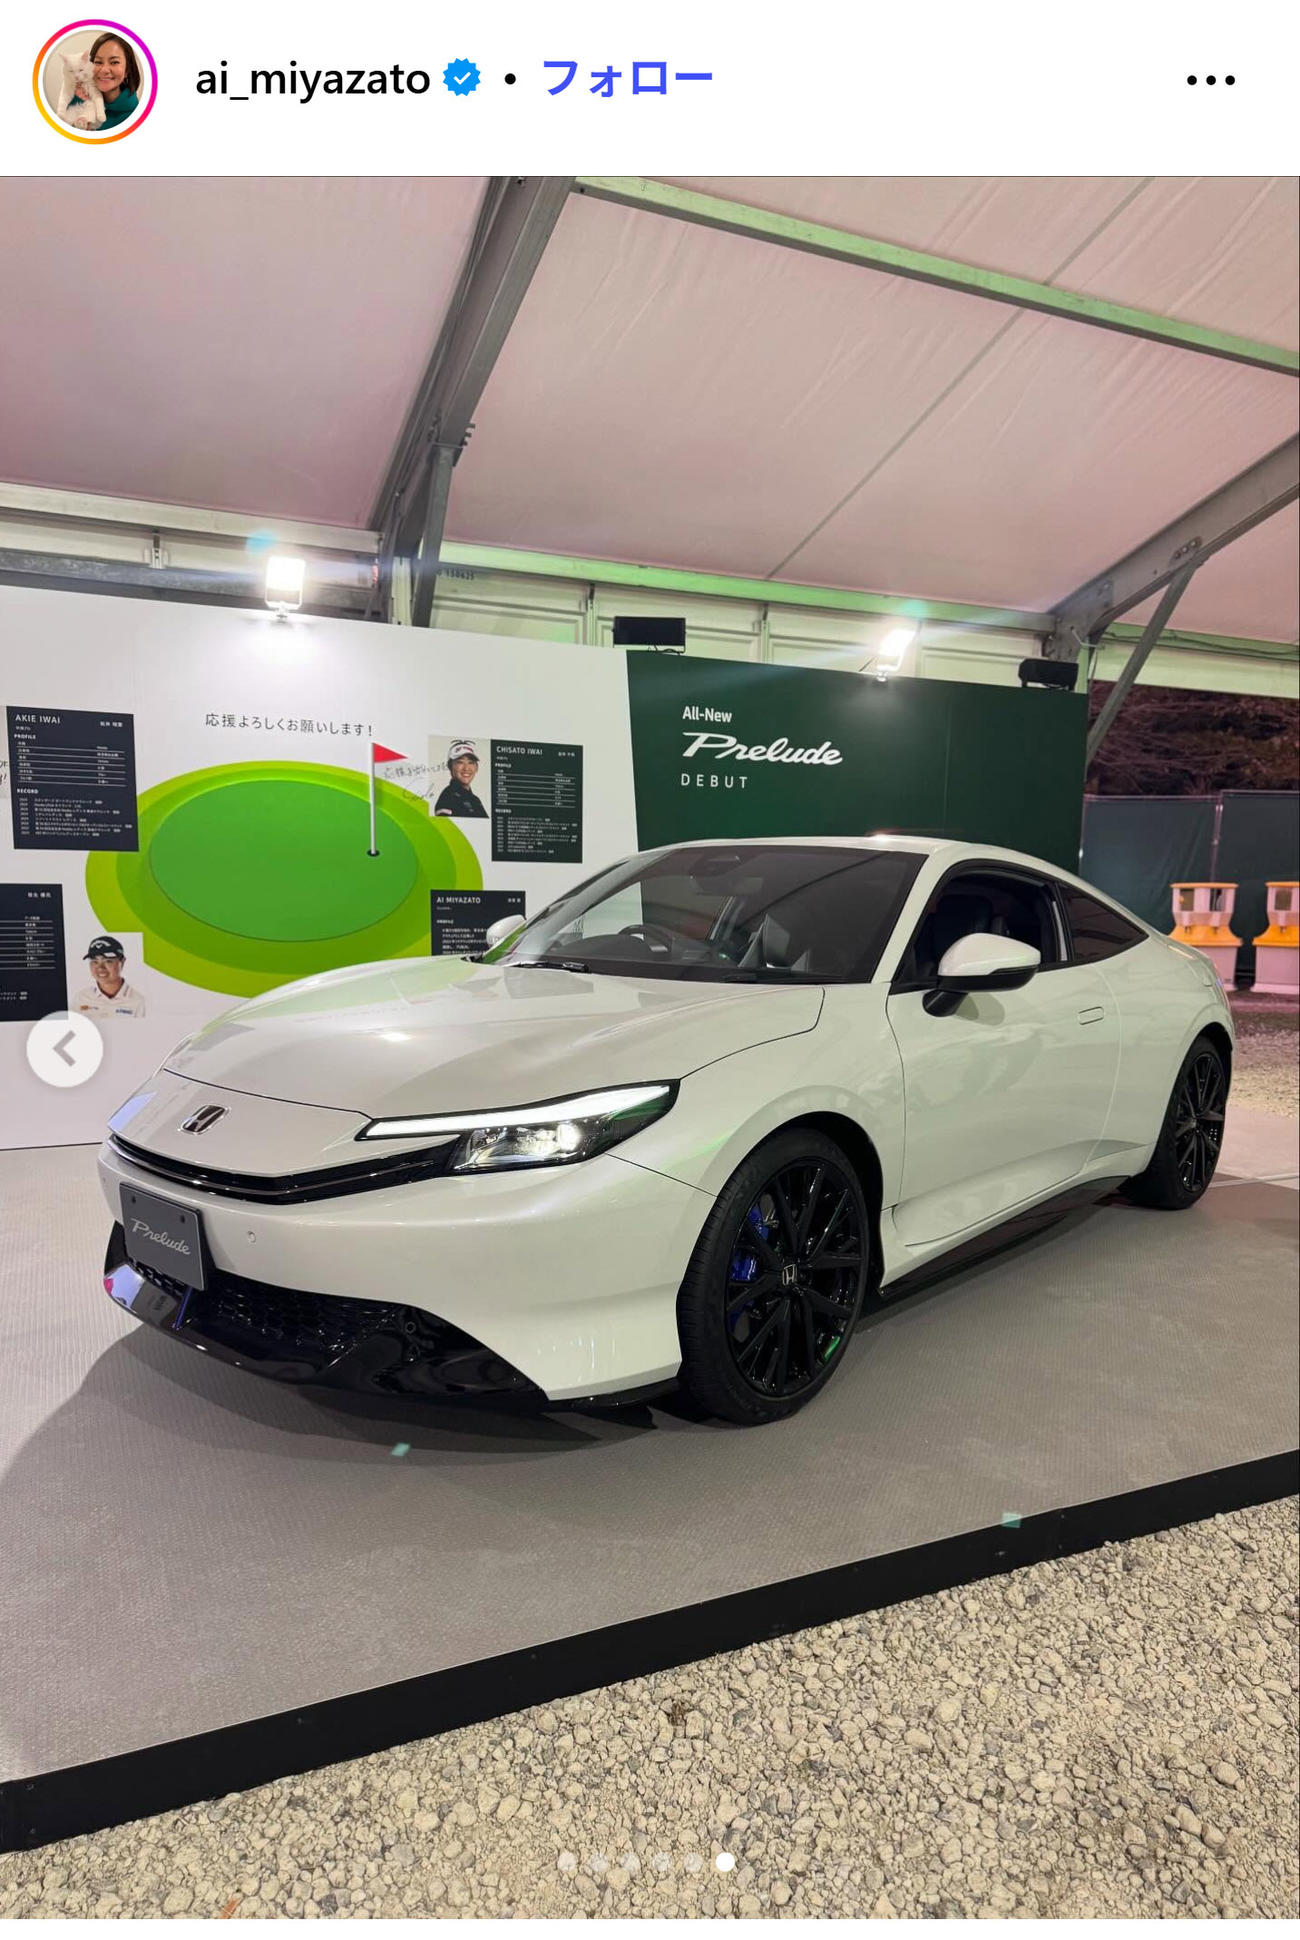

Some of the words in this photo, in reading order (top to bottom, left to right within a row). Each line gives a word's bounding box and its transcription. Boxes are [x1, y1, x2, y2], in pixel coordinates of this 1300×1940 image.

[15, 714, 37, 723] AKIE
[39, 715, 61, 725] IWAI
[682, 706, 733, 723] All-New
[496, 745, 526, 755] CHISATO
[527, 748, 543, 756] IWAI
[682, 732, 843, 765] Prelude
[681, 773, 748, 789] DEBUT
[436, 896, 445, 904] AI
[446, 896, 481, 904] MIYAZATO
[131, 1217, 191, 1256] Prelude
